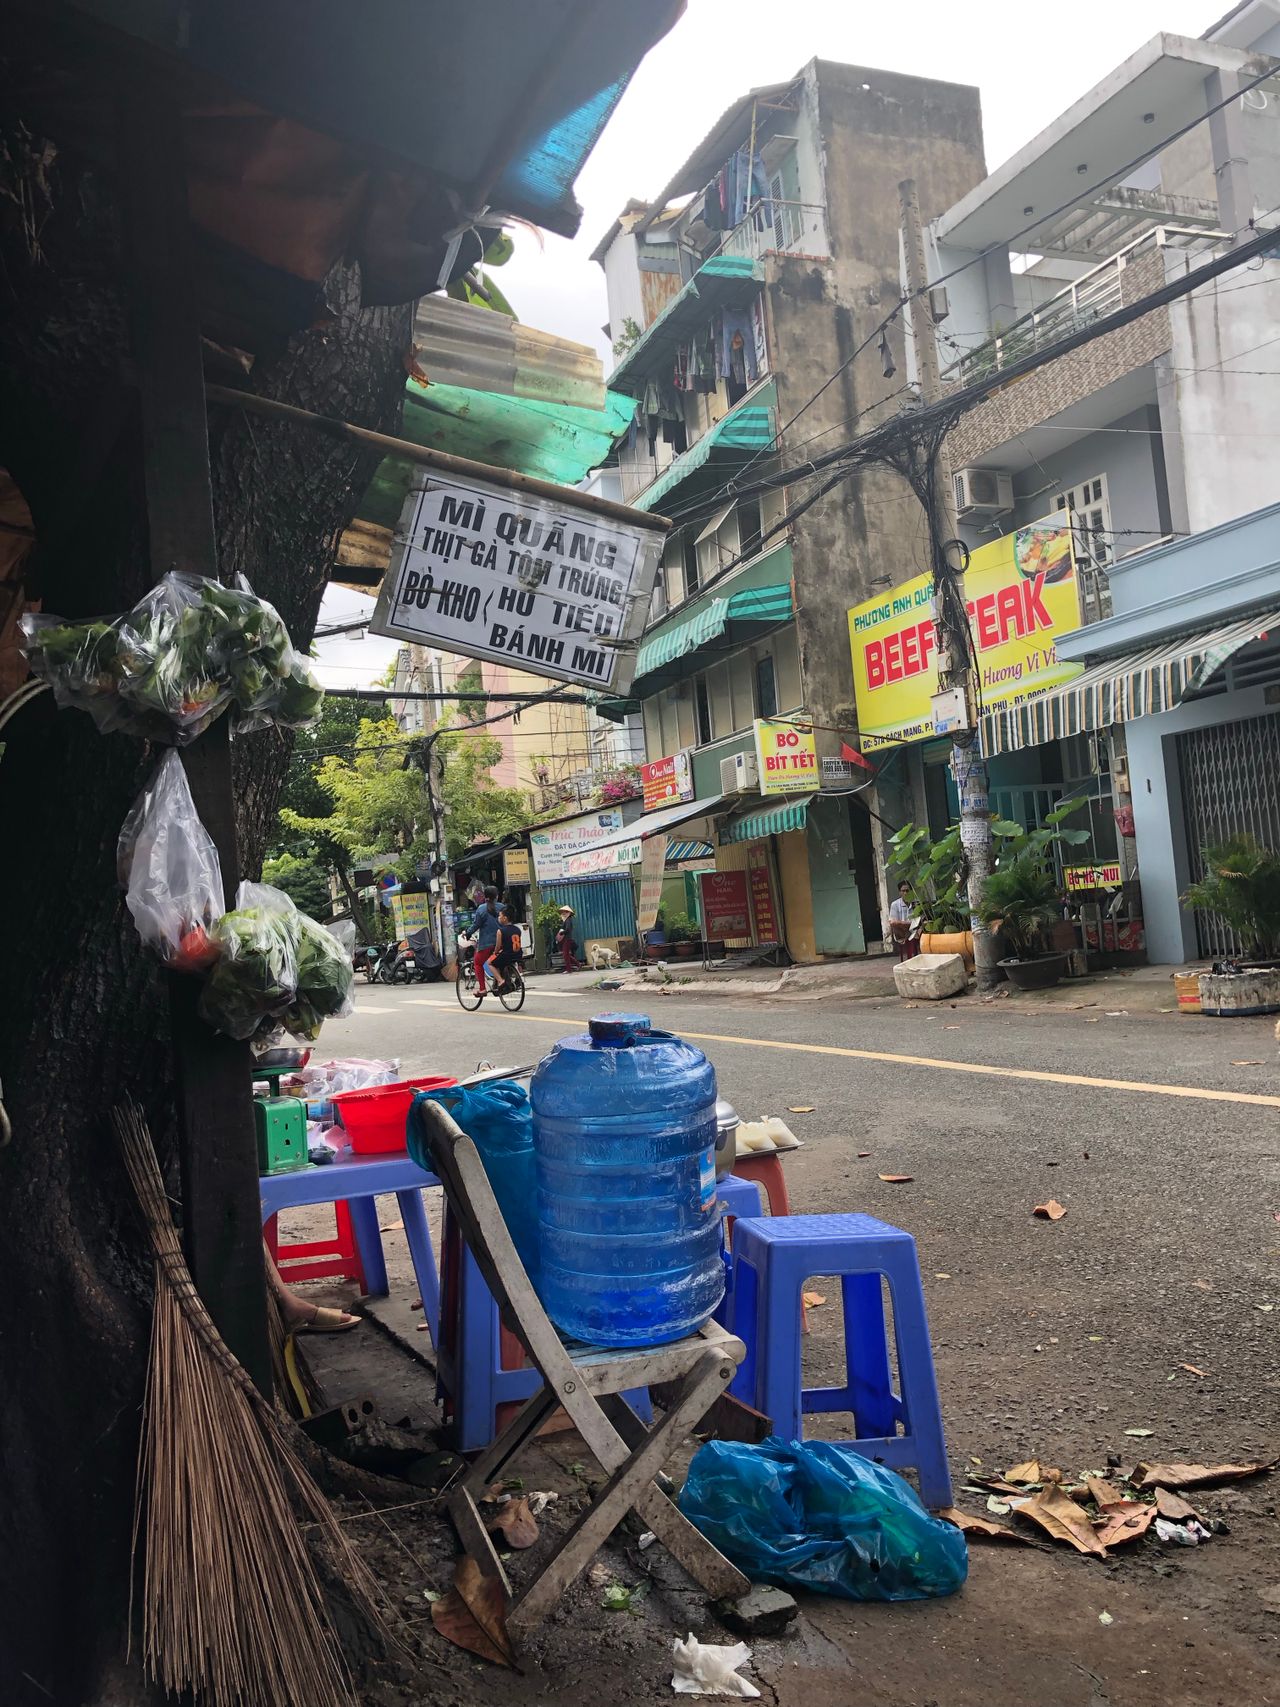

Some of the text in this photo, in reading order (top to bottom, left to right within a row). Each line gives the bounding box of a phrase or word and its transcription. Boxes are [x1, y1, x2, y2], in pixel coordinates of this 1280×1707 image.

[438, 495, 486, 532] MÌ
[422, 526, 624, 605] THỊT GÀ TÔM TRỨNG
[402, 566, 434, 609] BÒ
[436, 579, 481, 622] KHO
[552, 600, 614, 636] TIẾU
[893, 594, 912, 615] ANH
[914, 581, 935, 606] QUÁ
[489, 623, 606, 675] BÁNH MÌ
[1026, 652, 1039, 673] Vị
[776, 729, 799, 748] BÒ
[766, 748, 815, 770] BÍT TẾT
[1103, 867, 1120, 881] NUI
[512, 934, 521, 951] 8
